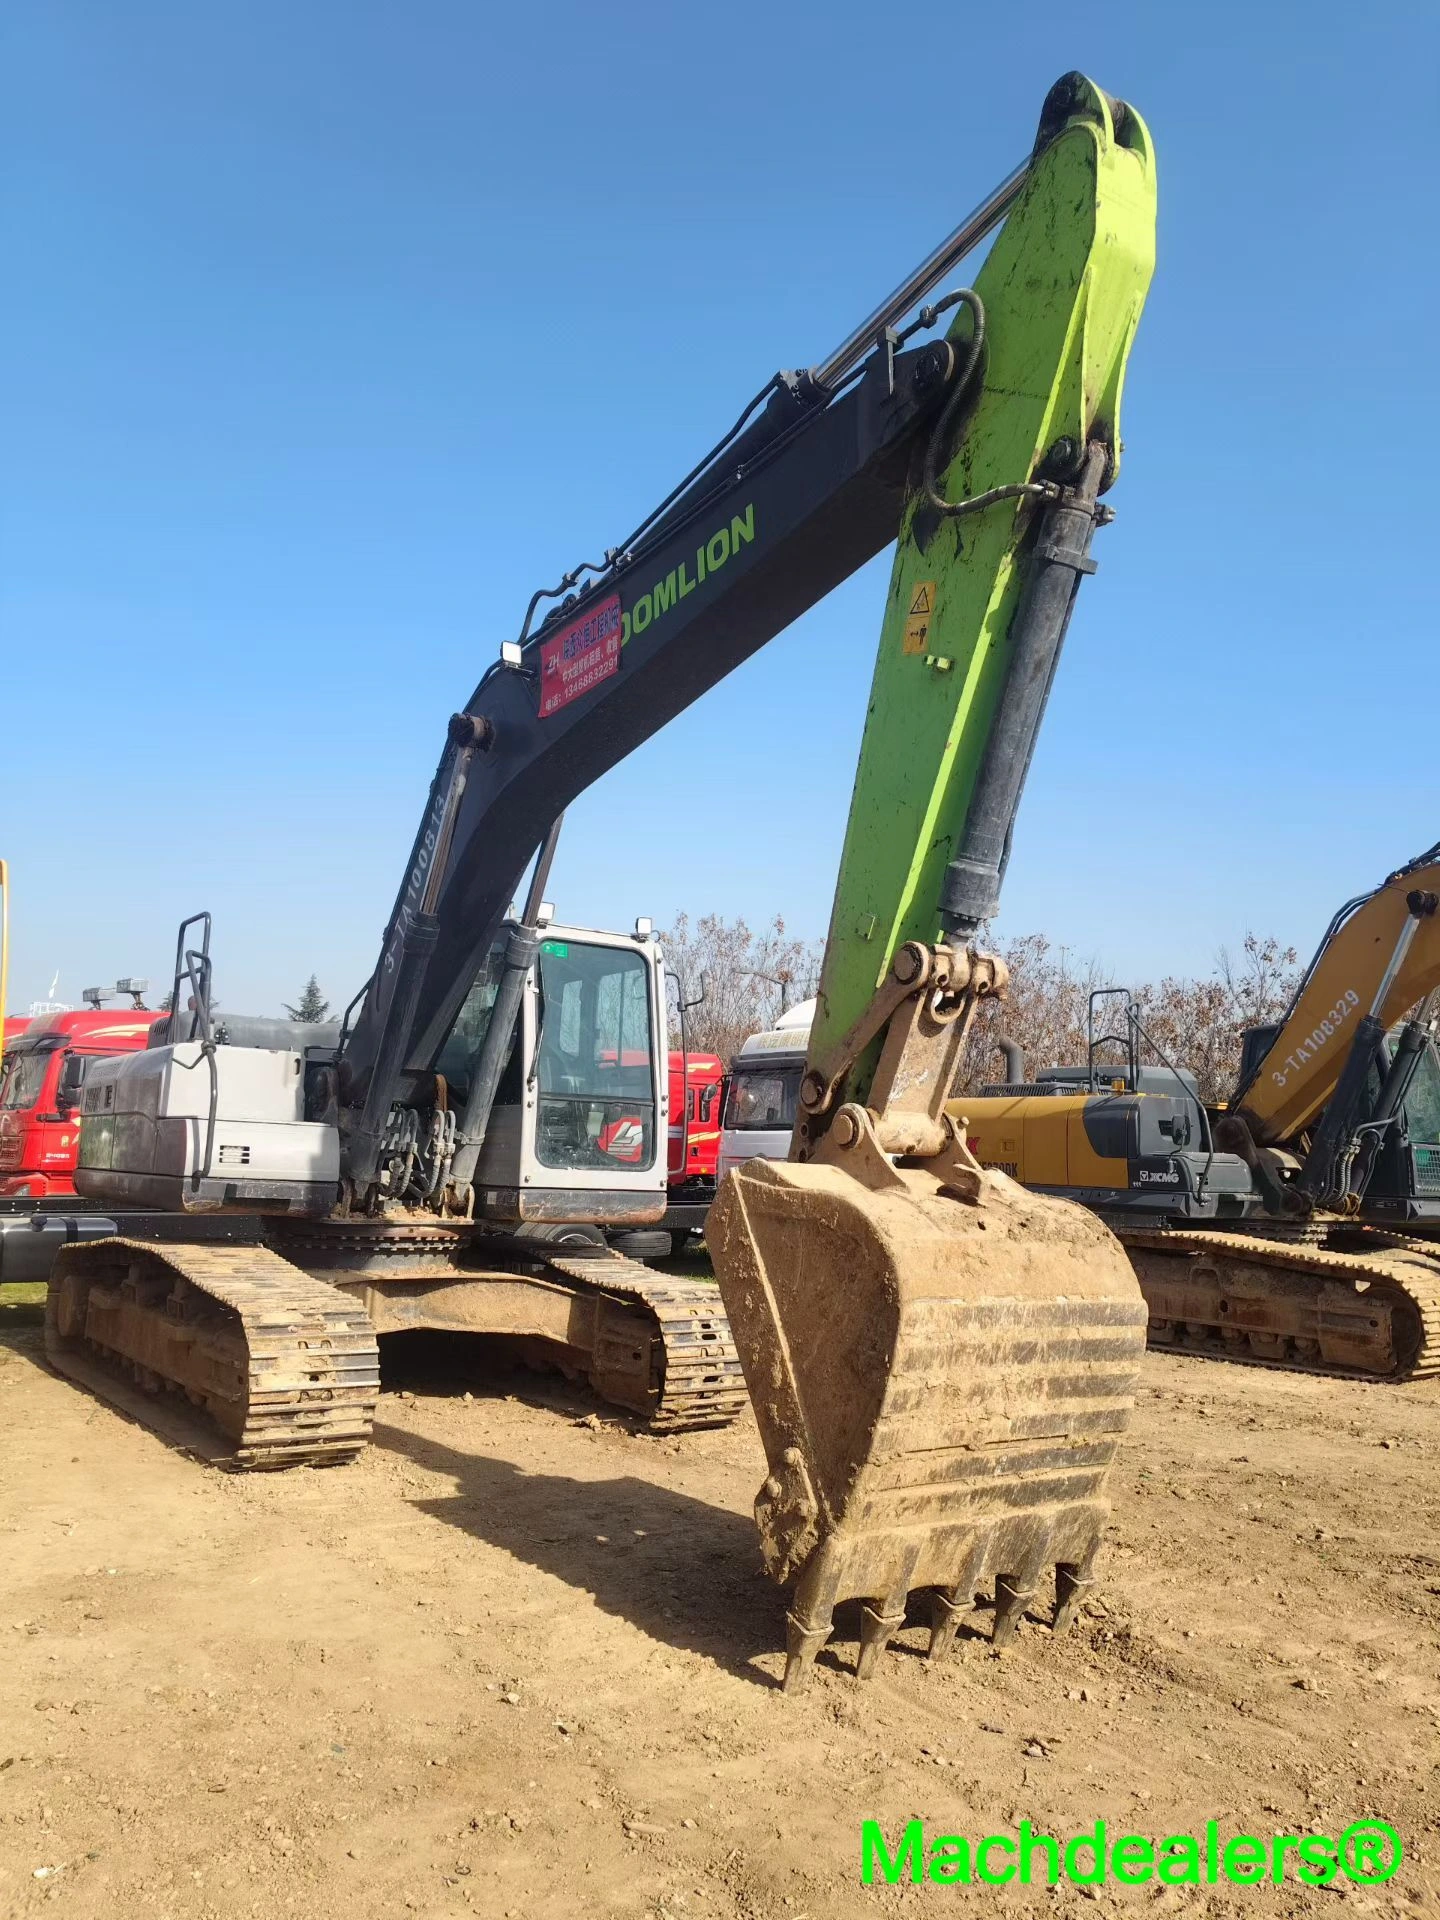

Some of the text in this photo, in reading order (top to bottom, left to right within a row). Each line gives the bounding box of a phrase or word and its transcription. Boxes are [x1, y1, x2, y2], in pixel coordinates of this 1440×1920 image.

[621, 503, 755, 647] OOMLION
[384, 793, 445, 974] 3-TA100813
[1272, 989, 1360, 1088] 3-TA108329
[1149, 1172, 1180, 1184] XCMG
